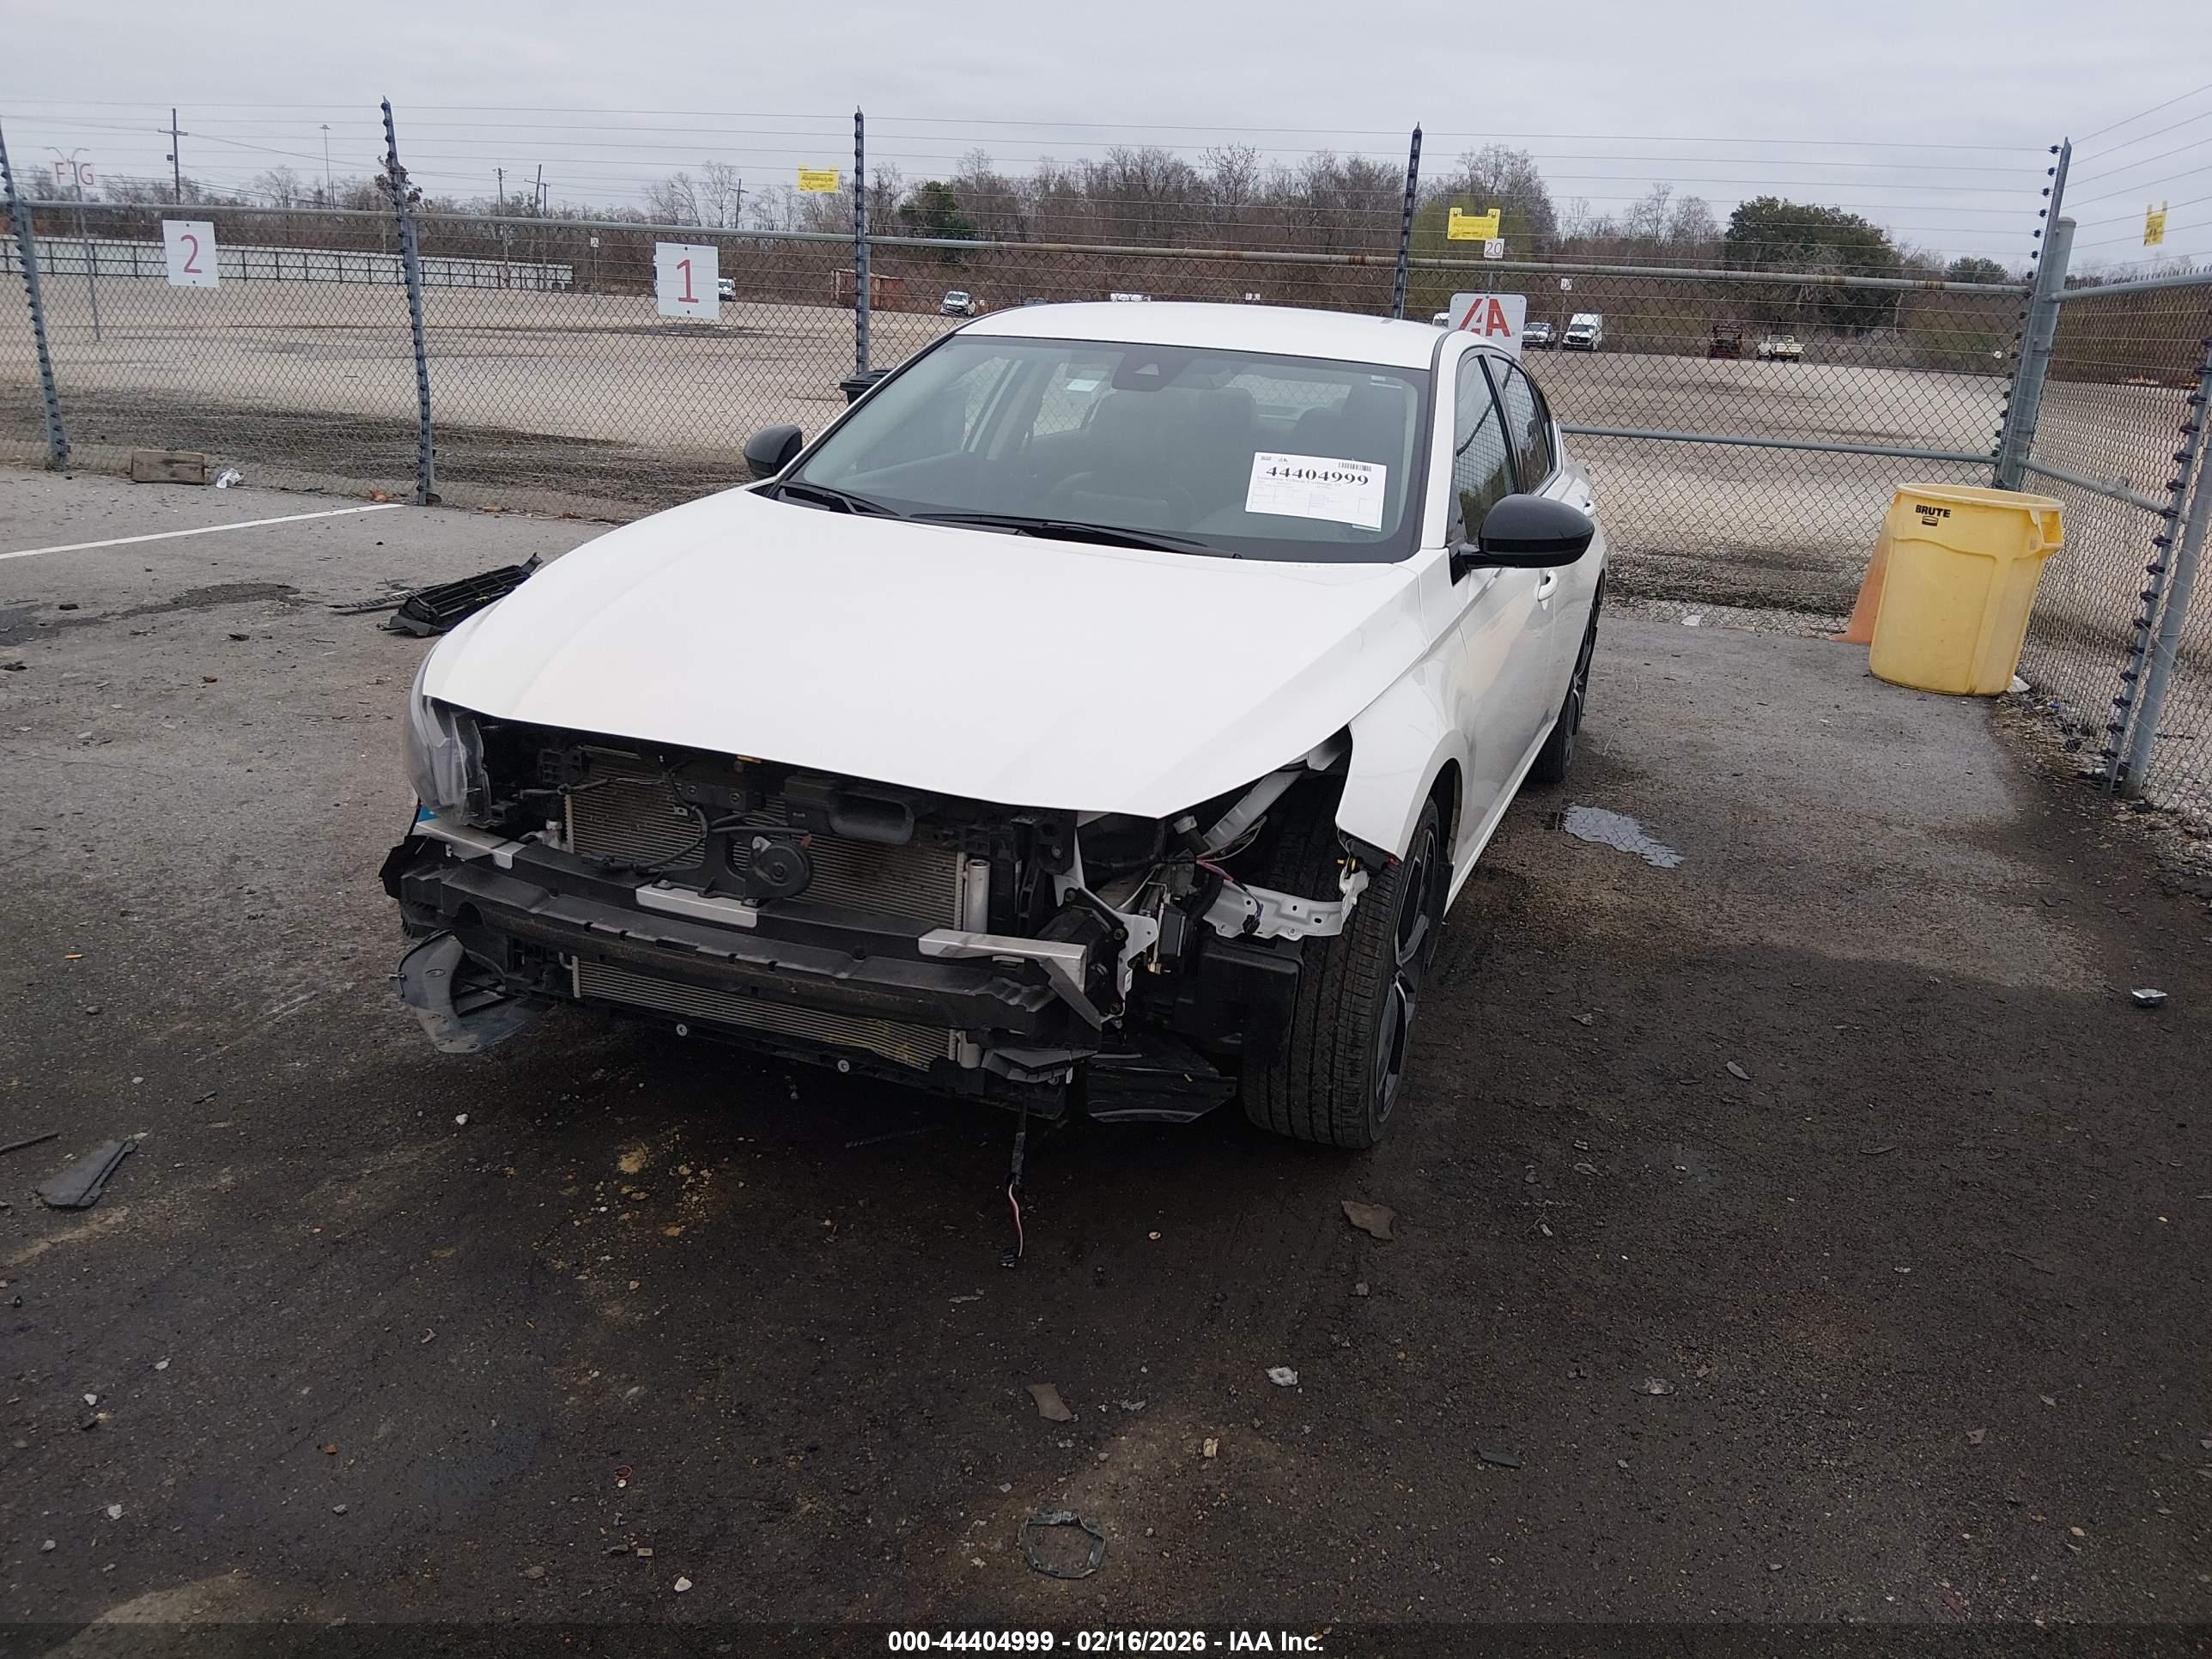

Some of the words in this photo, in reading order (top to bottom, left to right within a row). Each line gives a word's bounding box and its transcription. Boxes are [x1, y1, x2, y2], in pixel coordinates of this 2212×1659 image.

[54, 162, 64, 185] F
[79, 163, 94, 185] G
[180, 234, 203, 273] 2
[1485, 241, 1503, 255] 20
[677, 259, 699, 303] 1
[1266, 466, 1369, 486] 44404999
[1915, 504, 1952, 519] BRUTE
